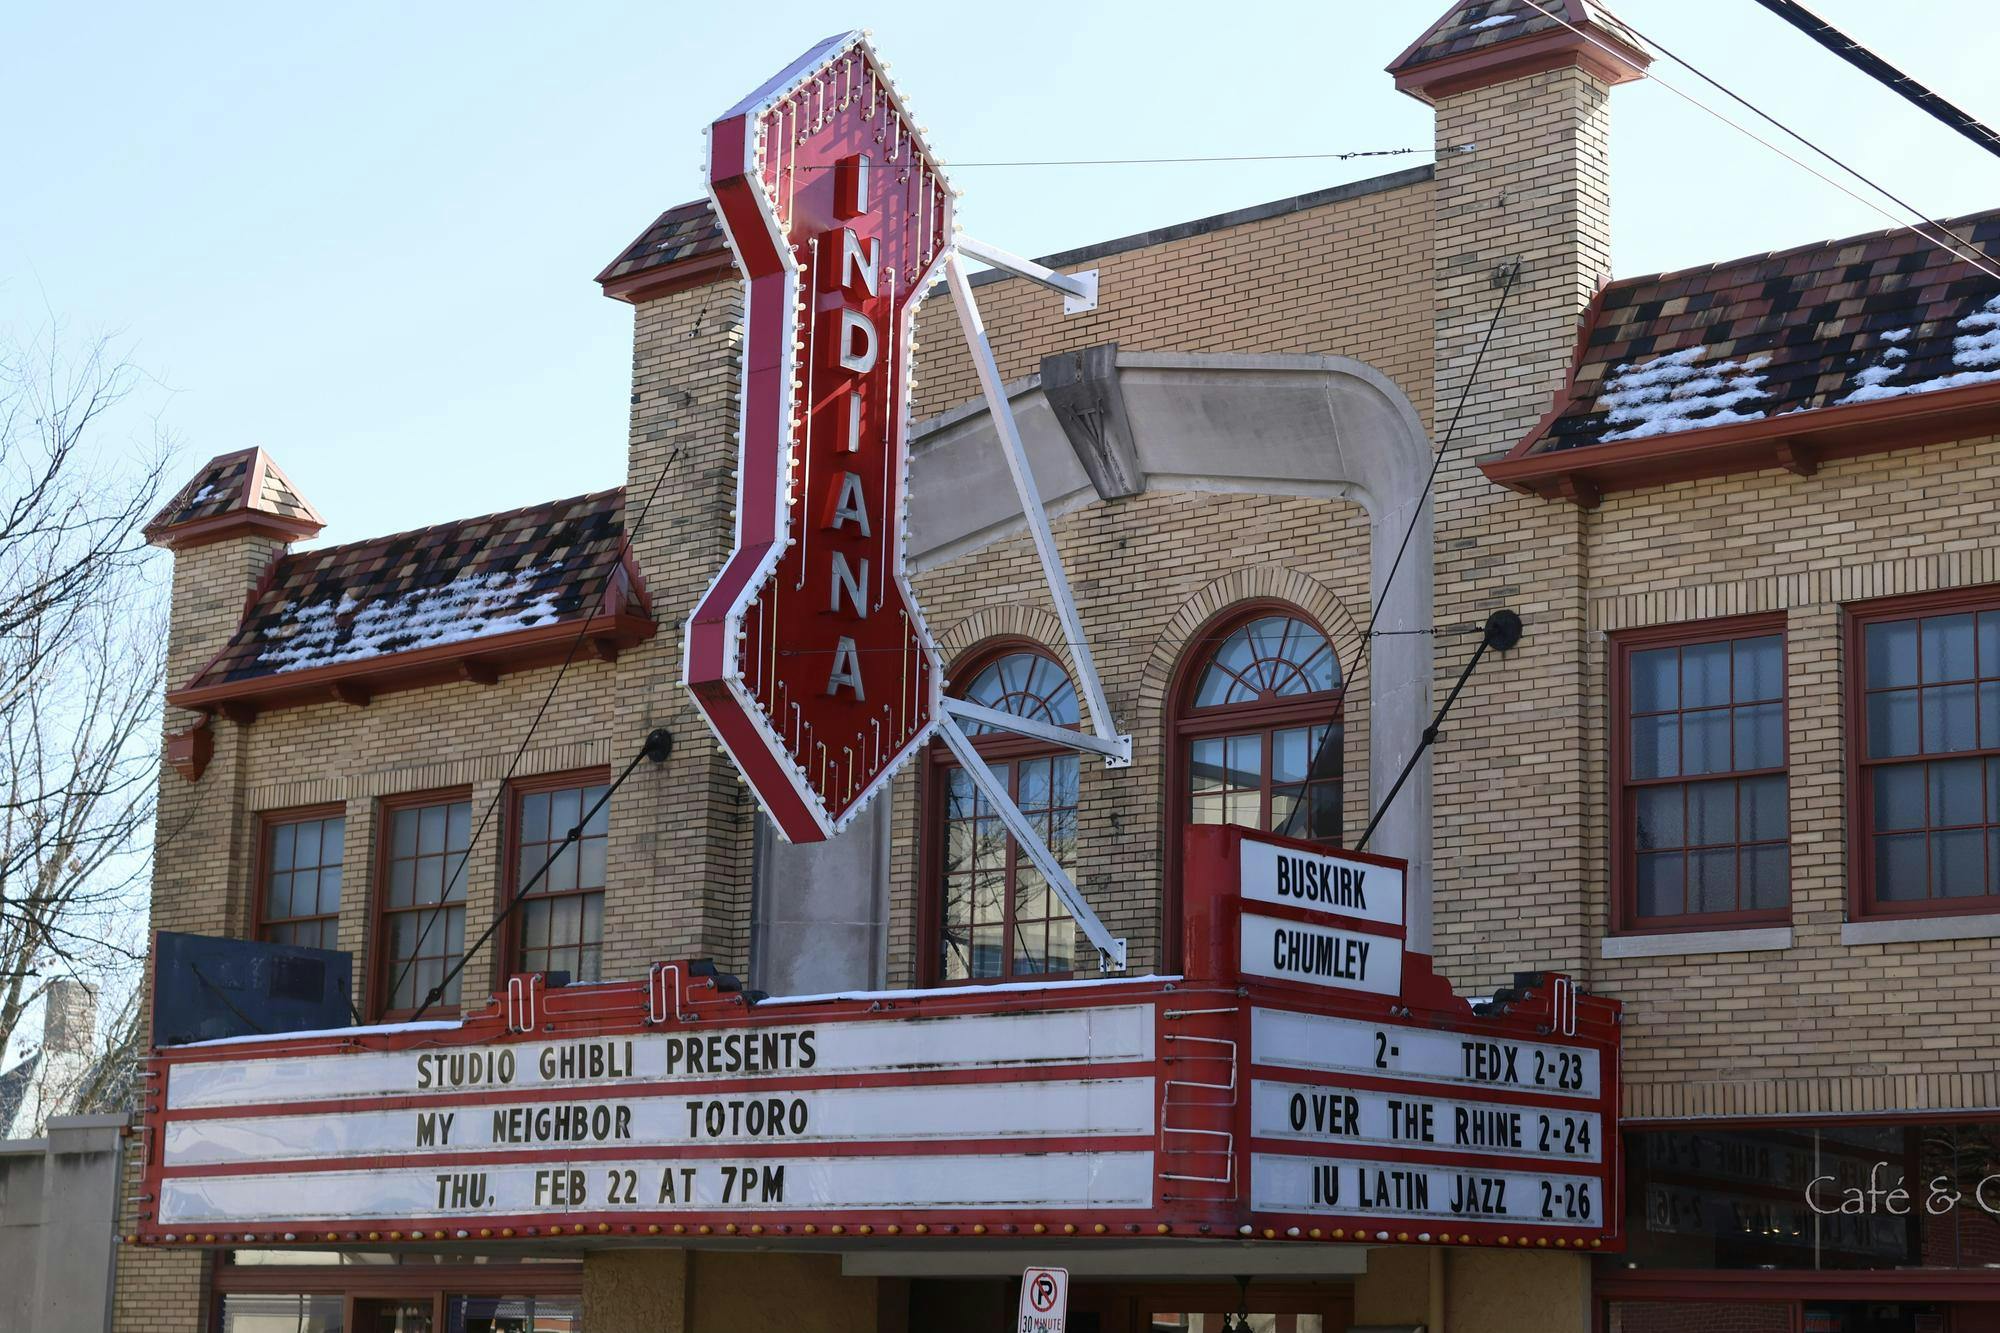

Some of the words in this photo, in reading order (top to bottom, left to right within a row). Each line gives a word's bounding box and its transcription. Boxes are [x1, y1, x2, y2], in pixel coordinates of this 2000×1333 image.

[825, 152, 881, 702] INDIANA
[1276, 855, 1367, 910] BUSKIRK
[1273, 928, 1370, 981] CHUMLEY
[416, 1048, 516, 1089] STUDIO
[539, 1041, 633, 1081] GHIBLI
[665, 1030, 817, 1075] PRESENTS
[1375, 1031, 1399, 1069] 2-
[1461, 1042, 1518, 1083] TEDX
[1534, 1050, 1583, 1090] 2-23
[416, 1112, 455, 1147] MY
[492, 1105, 632, 1144] NEIGHBOR
[685, 1098, 809, 1138] TOTORO
[1289, 1092, 1360, 1136] OVER
[1387, 1100, 1434, 1142] THE
[1454, 1107, 1522, 1148] RHINE
[1538, 1114, 1591, 1153] 2-24
[533, 1169, 588, 1206] FEB
[606, 1169, 638, 1205] 22
[657, 1167, 696, 1204] AT
[720, 1164, 785, 1204] 7PM
[1313, 1165, 1339, 1206] IU
[1358, 1167, 1429, 1211] LATIN
[1449, 1174, 1507, 1214] JAZZ
[1541, 1180, 1590, 1219] 2-26
[1805, 1161, 1911, 1215] Café
[1925, 1175, 1962, 1215] &
[1023, 1315, 1033, 1333] 30
